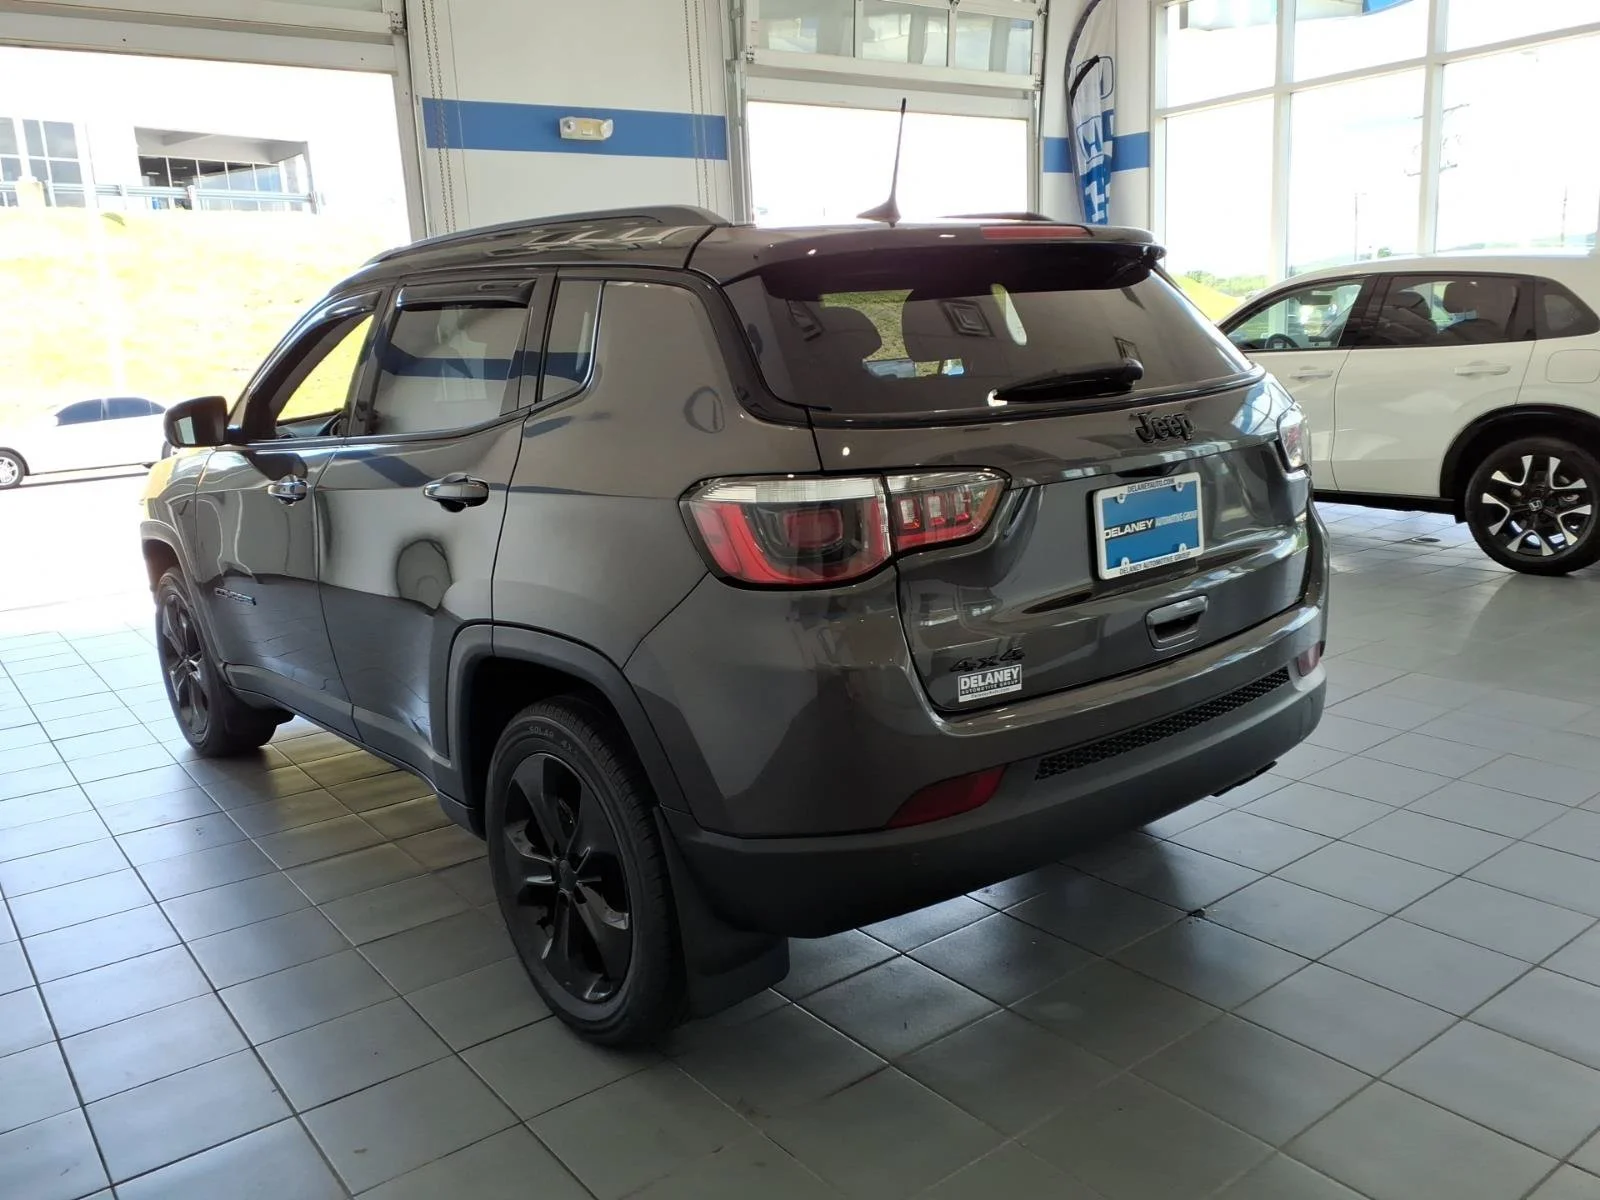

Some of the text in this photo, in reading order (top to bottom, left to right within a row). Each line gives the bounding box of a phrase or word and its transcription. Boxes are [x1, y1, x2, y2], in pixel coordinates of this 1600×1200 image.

[1134, 412, 1194, 443] Jeep
[1103, 518, 1155, 540] DELANEY
[960, 667, 1020, 690] DELANEY
